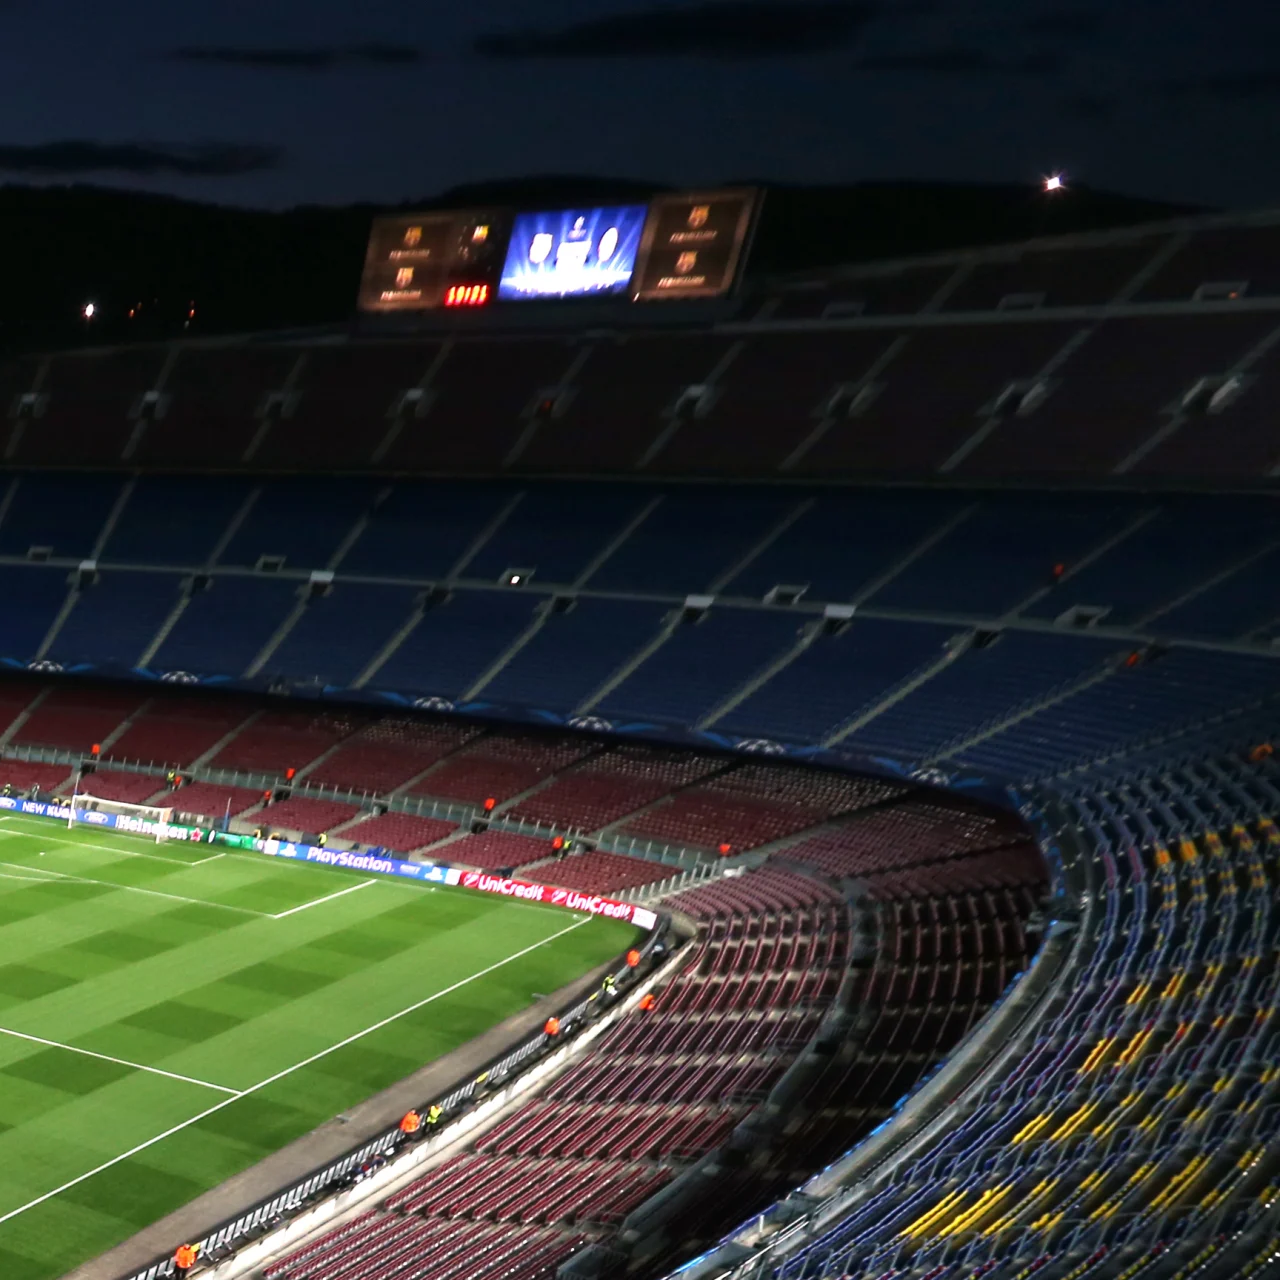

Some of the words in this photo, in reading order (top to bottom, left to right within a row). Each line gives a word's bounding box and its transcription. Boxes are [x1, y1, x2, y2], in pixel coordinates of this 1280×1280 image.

[22, 801, 45, 814] NEW
[478, 874, 544, 900] UniCredit
[566, 892, 631, 918] UniCredit
